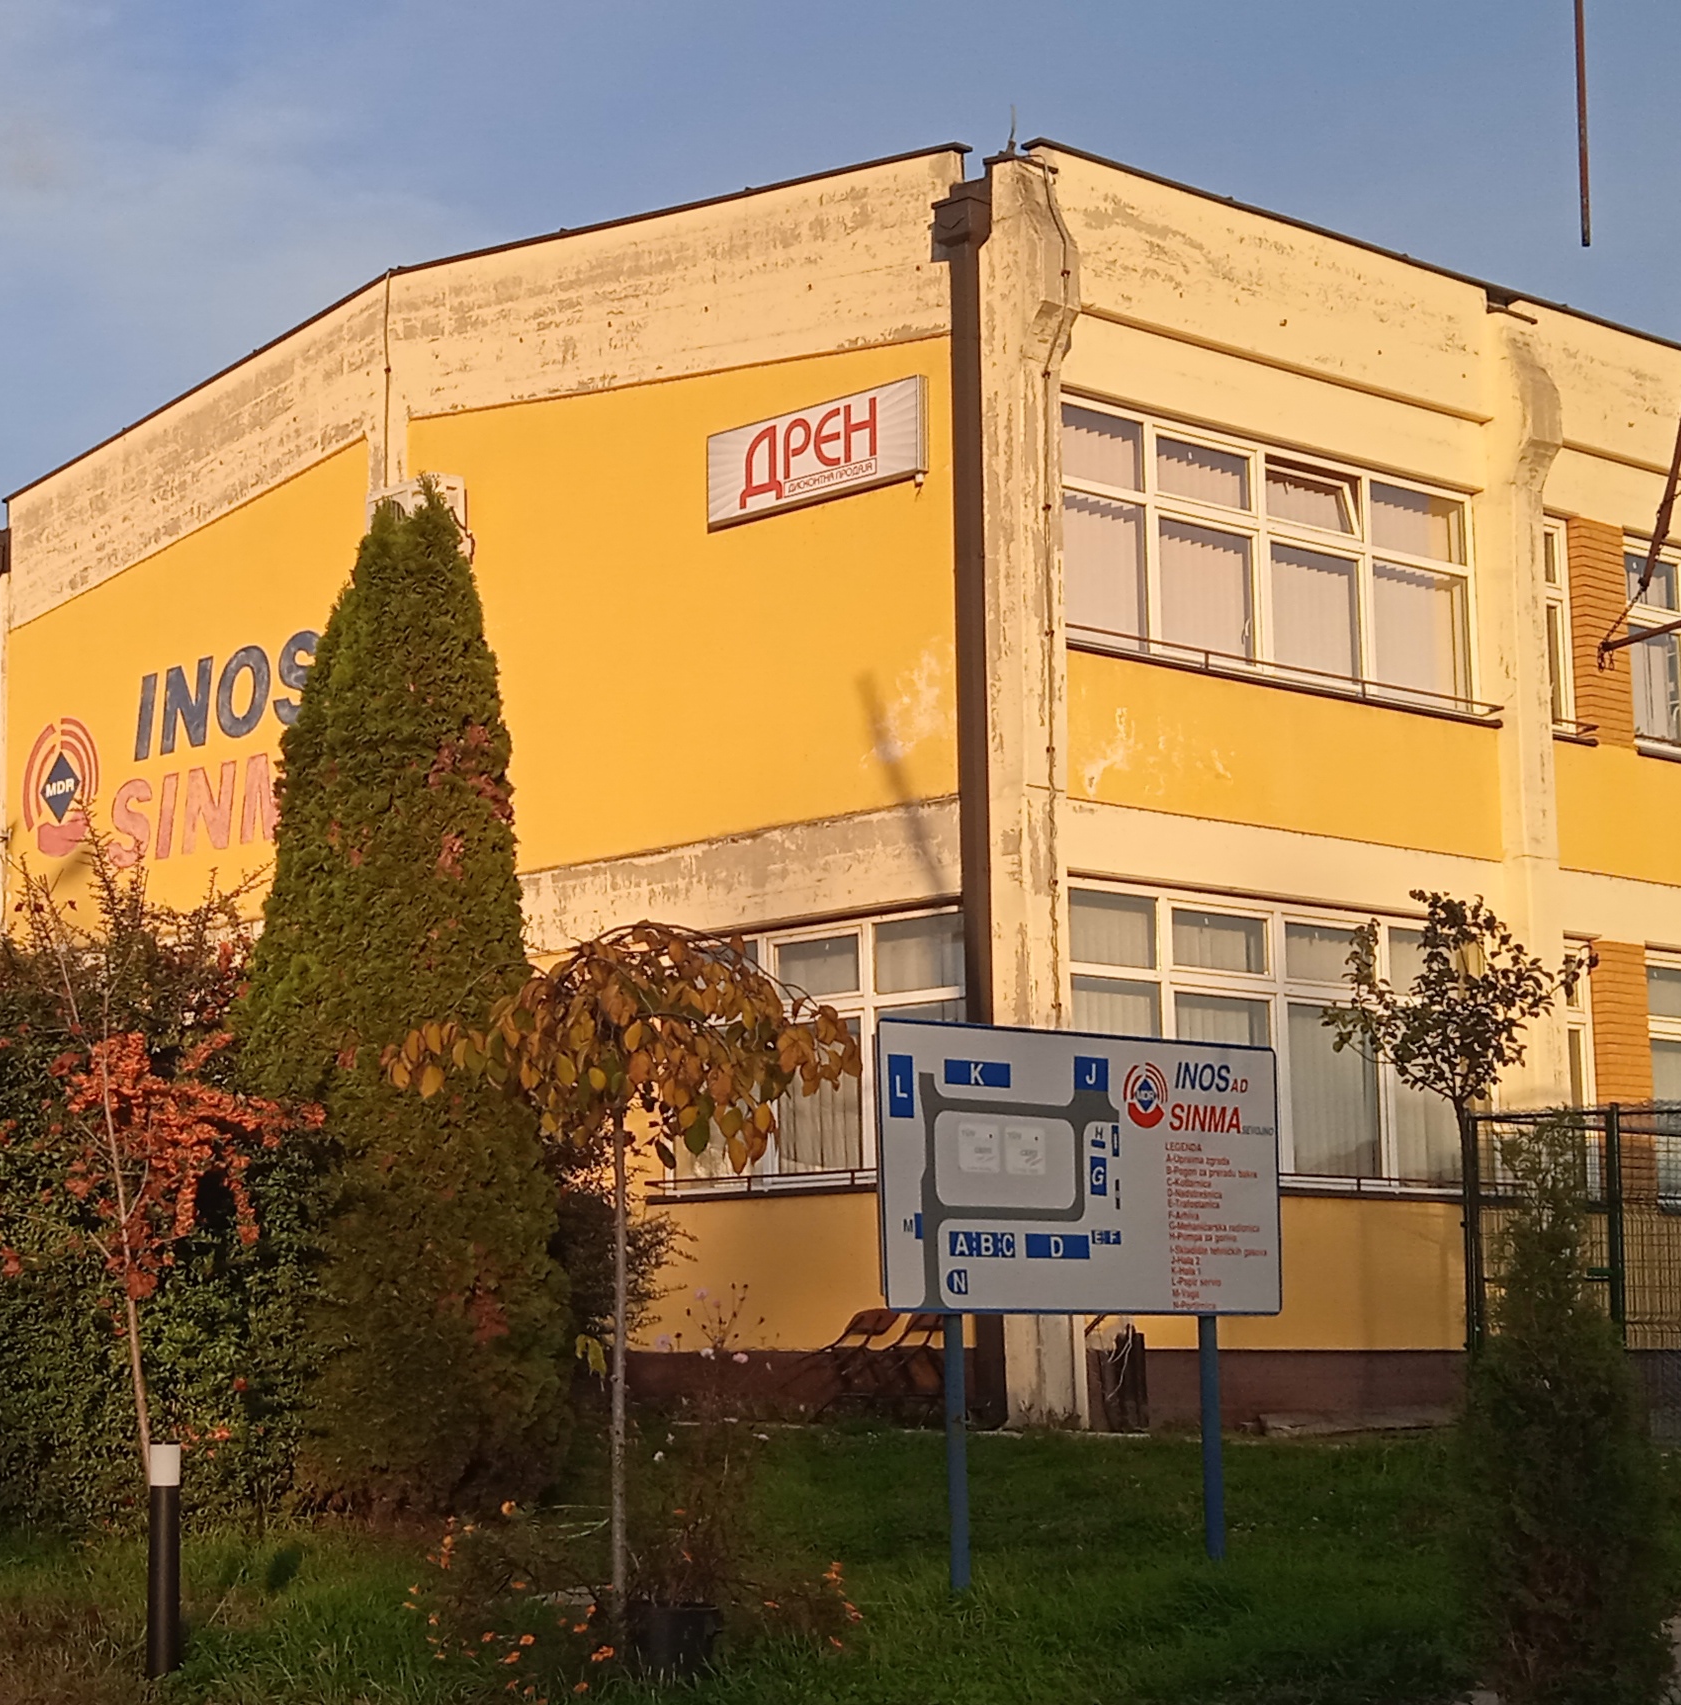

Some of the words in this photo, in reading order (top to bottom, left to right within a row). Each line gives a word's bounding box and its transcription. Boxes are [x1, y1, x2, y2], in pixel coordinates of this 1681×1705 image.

[740, 396, 877, 509] ДРЕН
[134, 630, 322, 762] INOS
[45, 777, 75, 797] MDR
[106, 752, 281, 868] SINM
[970, 1063, 984, 1086] K
[1085, 1062, 1096, 1085] J
[1174, 1061, 1231, 1093] INOS
[1230, 1078, 1249, 1094] AD
[895, 1074, 908, 1098] L
[1135, 1090, 1157, 1100] MDR
[1169, 1102, 1242, 1135] SINMA
[1095, 1125, 1104, 1139] H
[1165, 1142, 1202, 1152] LEGENDA
[1092, 1166, 1105, 1186] G
[903, 1219, 914, 1233] M
[955, 1233, 970, 1255] A
[980, 1234, 994, 1256] B
[1002, 1234, 1014, 1257] C
[1050, 1236, 1063, 1258] D
[1094, 1231, 1104, 1244] E
[1109, 1231, 1118, 1244] F
[952, 1272, 966, 1293] N
